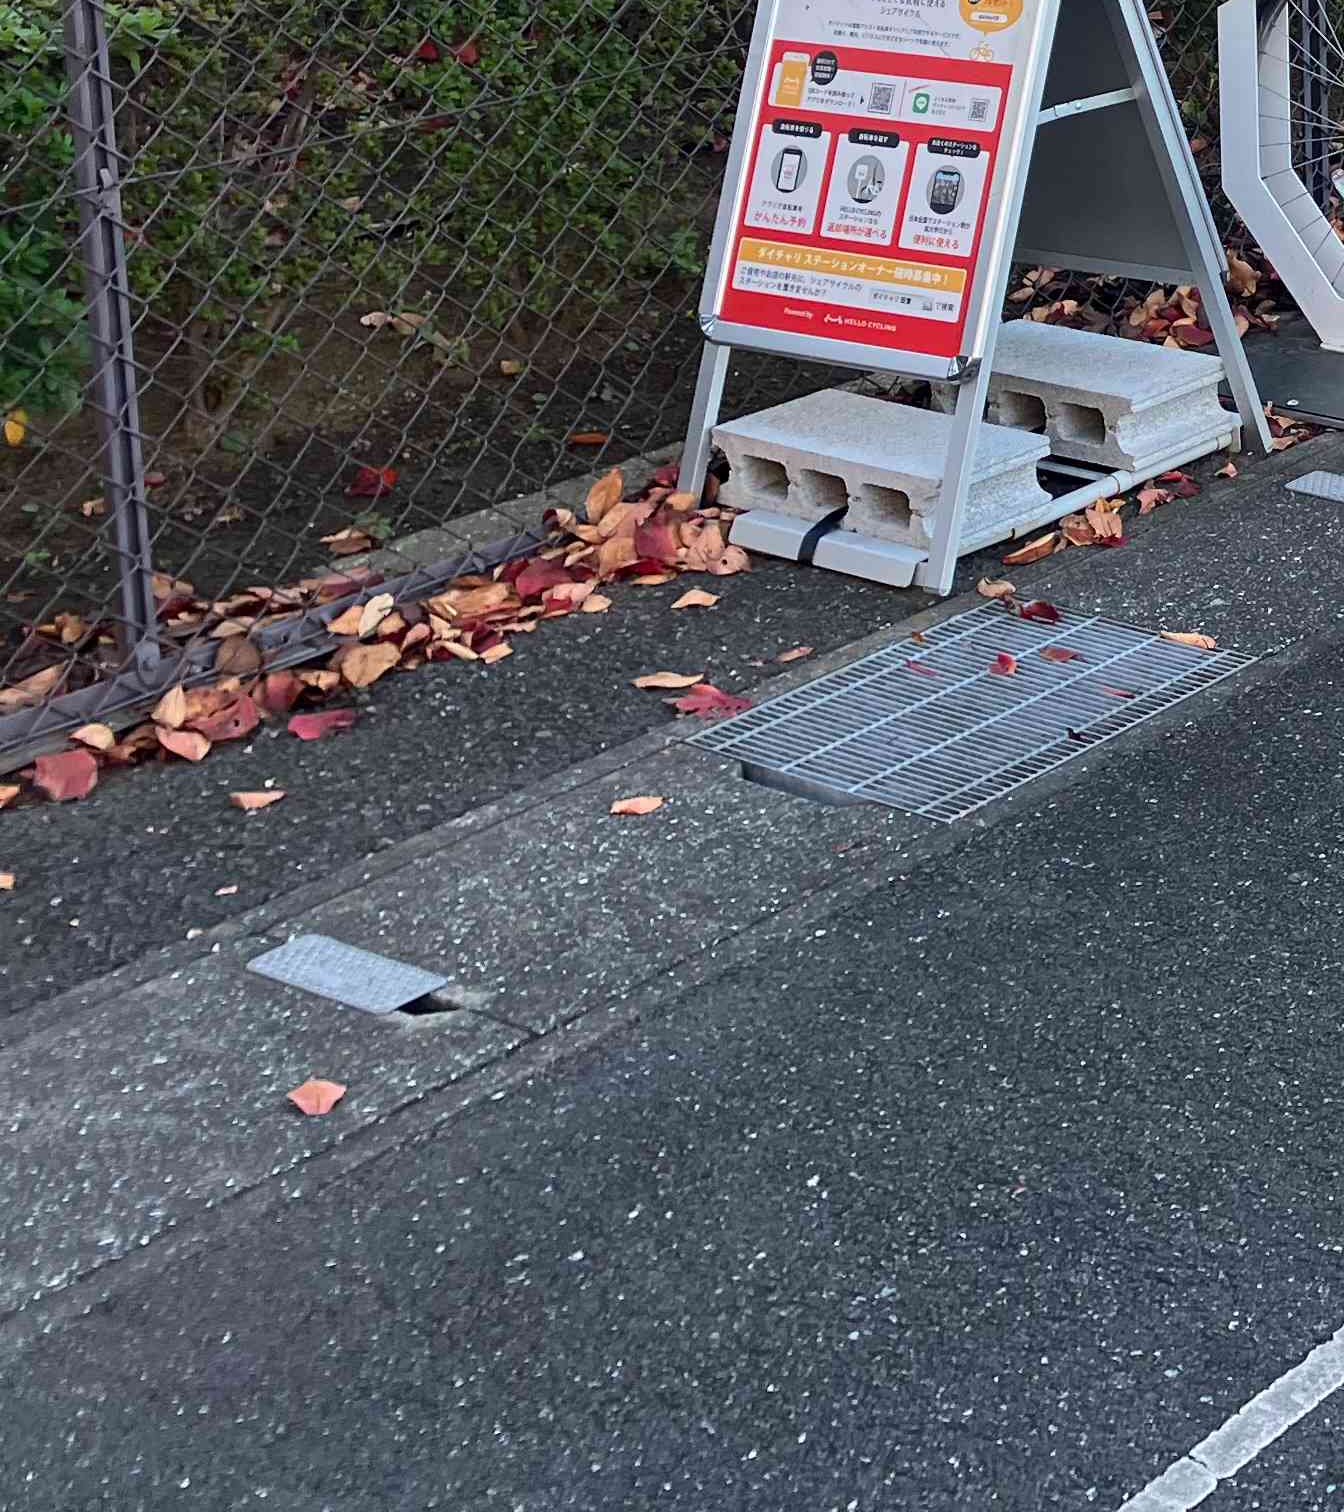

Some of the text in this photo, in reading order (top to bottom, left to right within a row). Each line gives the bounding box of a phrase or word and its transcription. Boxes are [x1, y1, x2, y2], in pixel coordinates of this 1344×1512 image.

[753, 210, 807, 229] かんたん予約
[912, 234, 960, 250] 便利に使える
[757, 245, 801, 264] ダイチャリ
[844, 317, 897, 333] HELLO CYCLING
